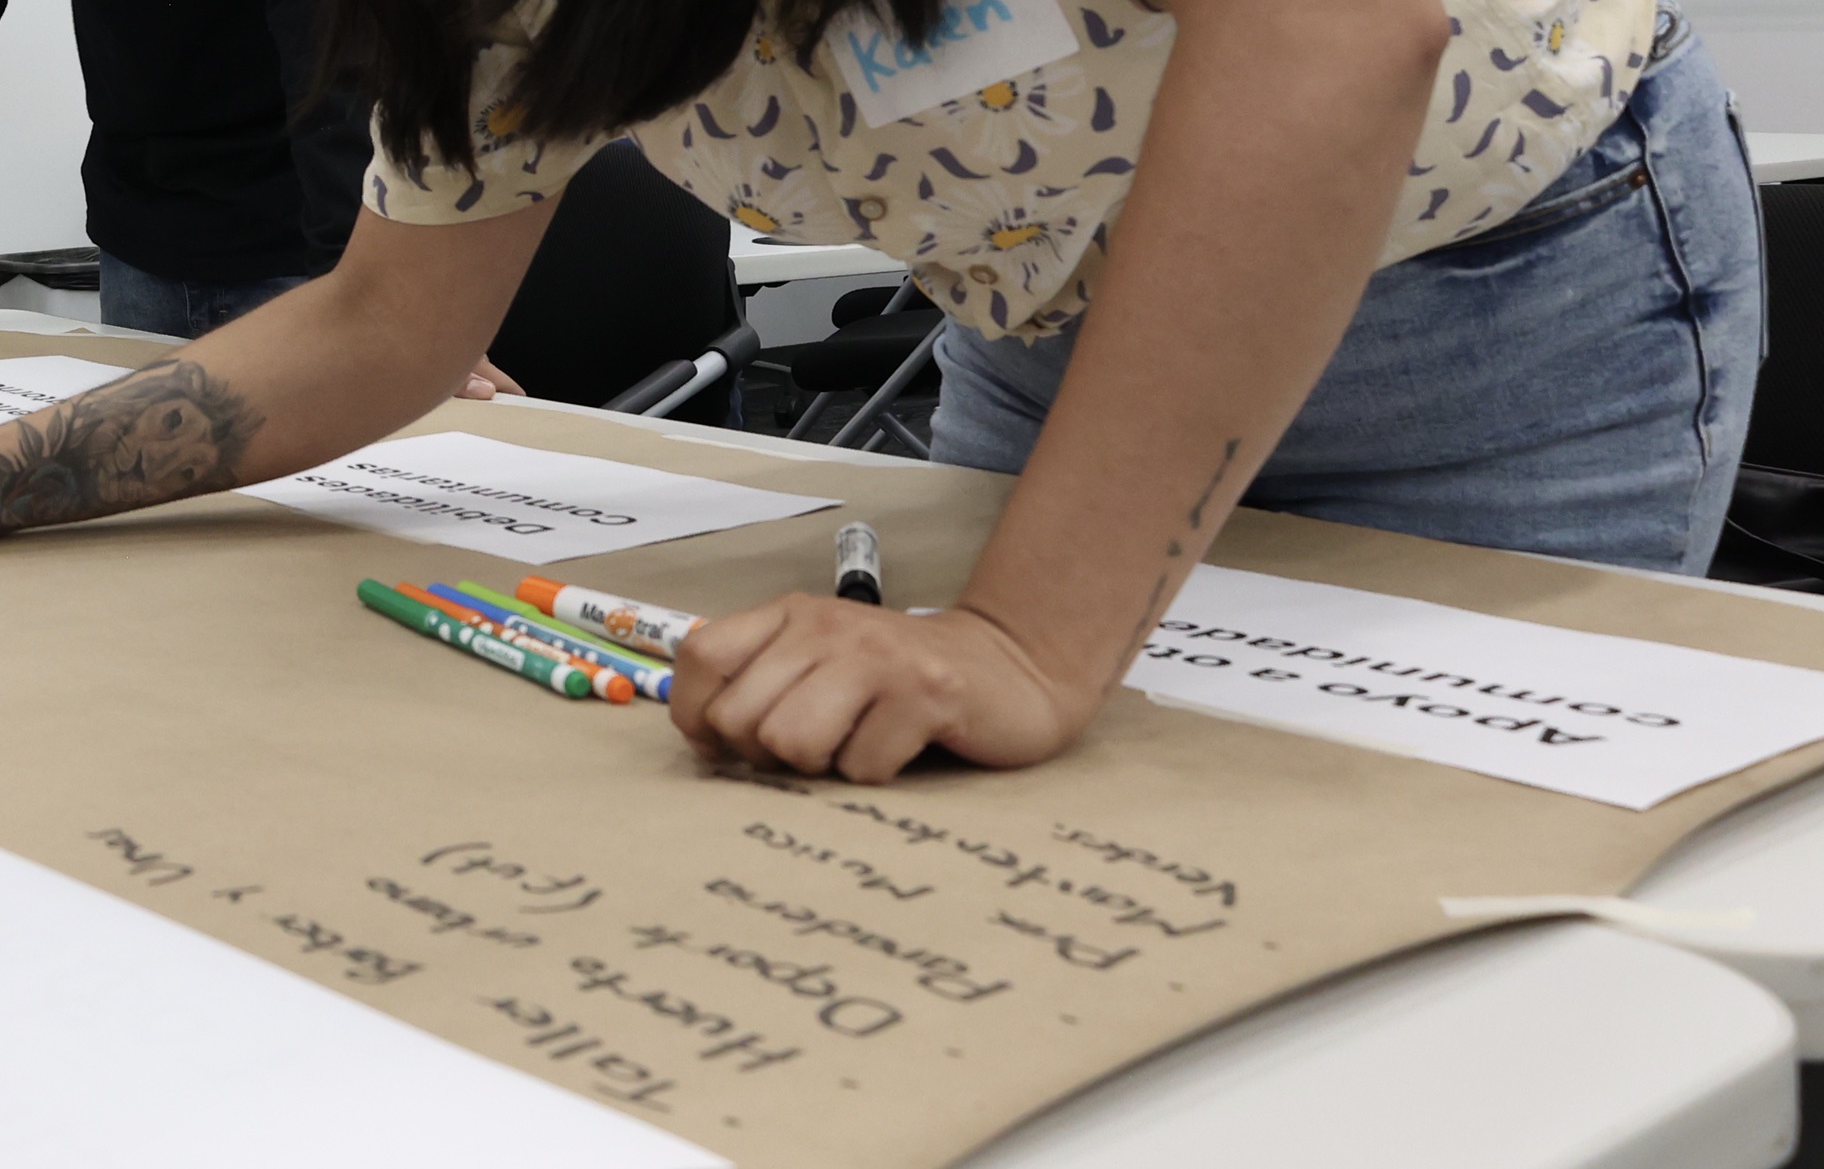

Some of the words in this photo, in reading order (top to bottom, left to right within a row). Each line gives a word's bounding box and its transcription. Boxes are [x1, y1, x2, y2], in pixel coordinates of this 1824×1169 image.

[295, 474, 556, 535] Debilidades
[346, 461, 639, 527] Comunitarias
[1158, 620, 1684, 730] comunidade
[1248, 667, 1302, 682] a
[1317, 681, 1609, 746] Apoyo
[569, 955, 804, 1075] Huerto
[478, 995, 676, 1114] Taller
